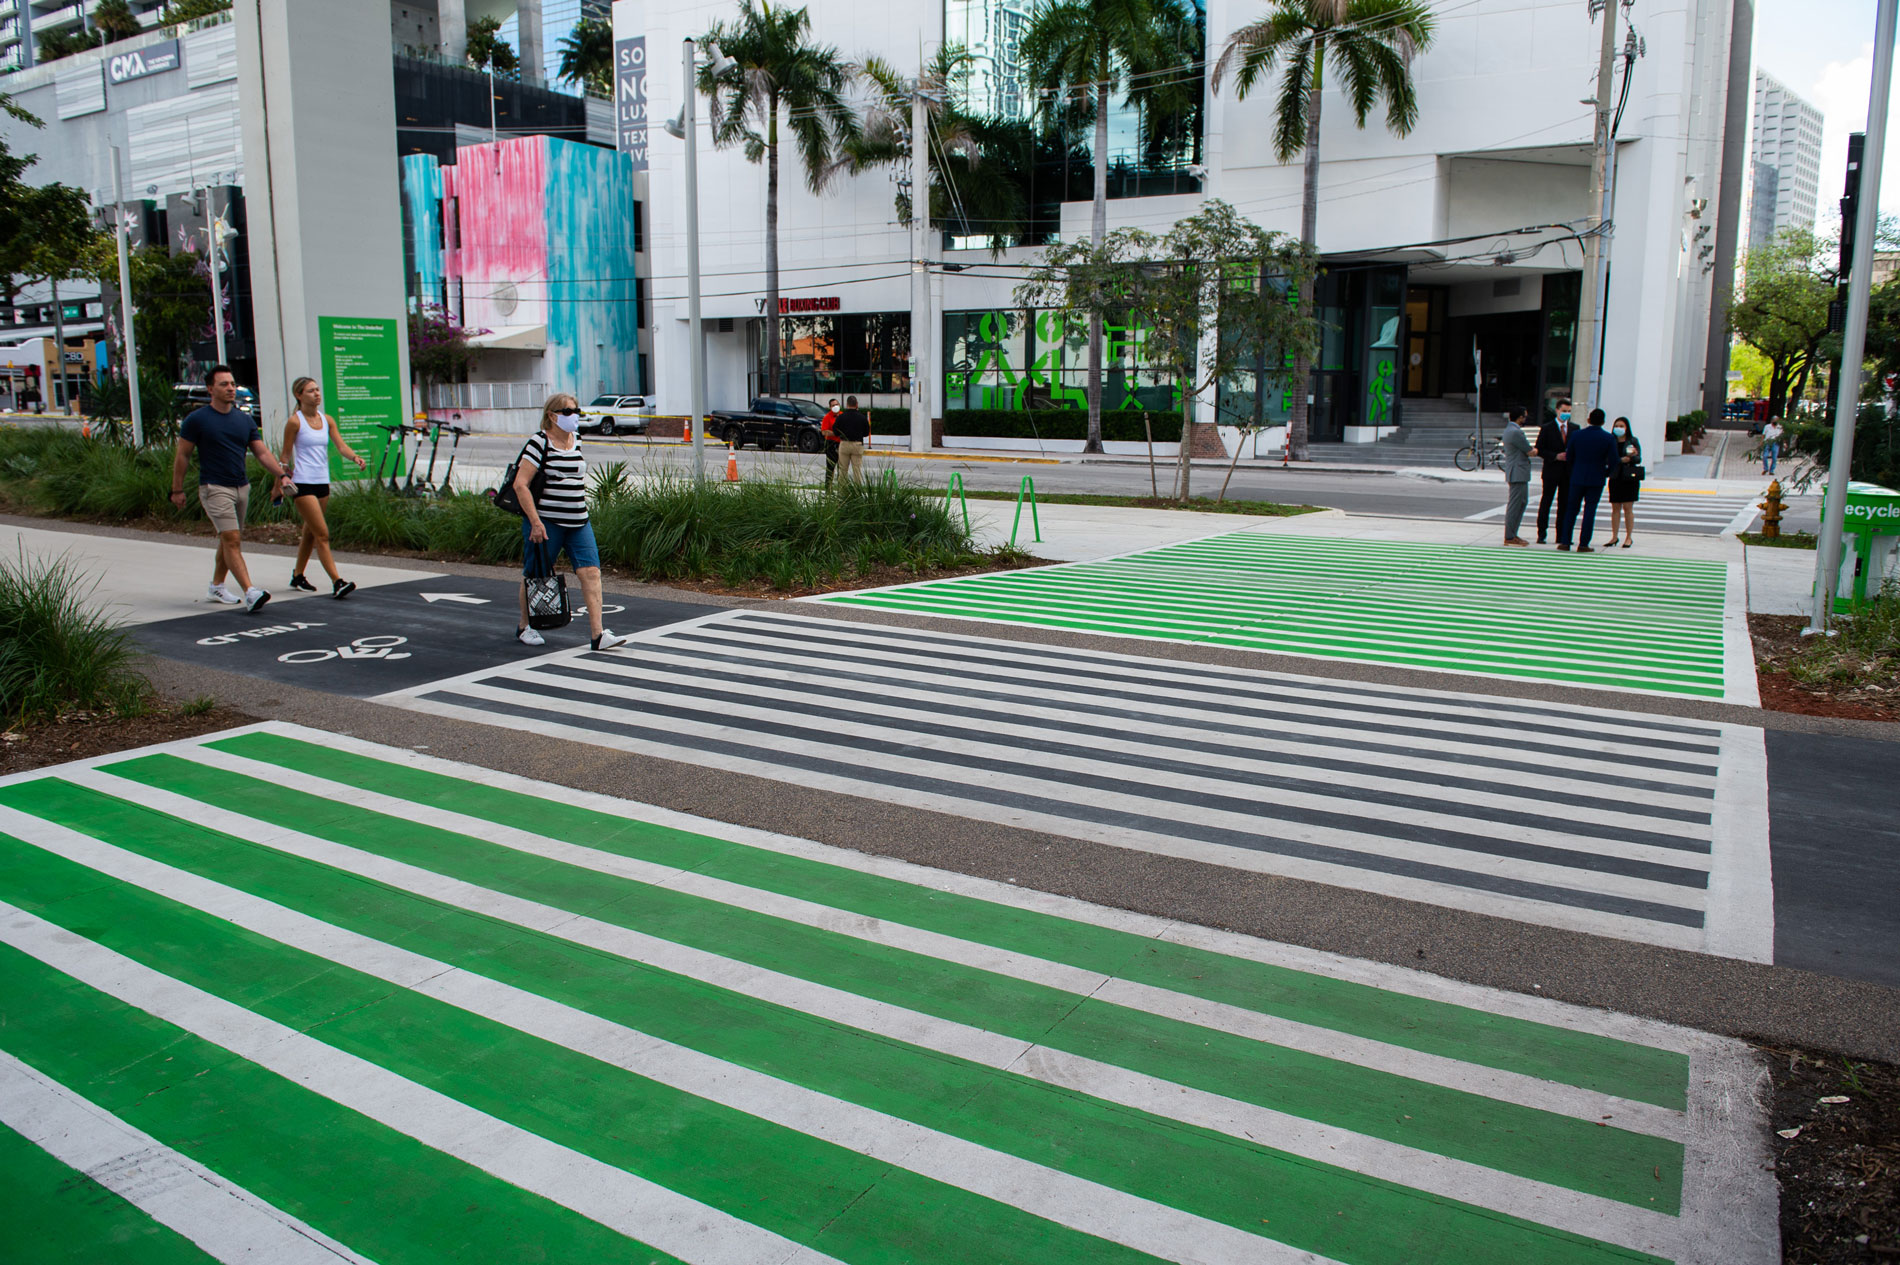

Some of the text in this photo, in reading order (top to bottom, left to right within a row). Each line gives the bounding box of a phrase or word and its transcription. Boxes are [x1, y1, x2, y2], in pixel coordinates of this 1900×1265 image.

[621, 46, 644, 66] SO
[111, 52, 147, 81] CMX
[624, 148, 649, 162] IVE
[790, 298, 819, 312] BOXING
[820, 297, 840, 310] CLUB
[1844, 503, 1900, 520] ecycle
[196, 622, 328, 645] YIELD
